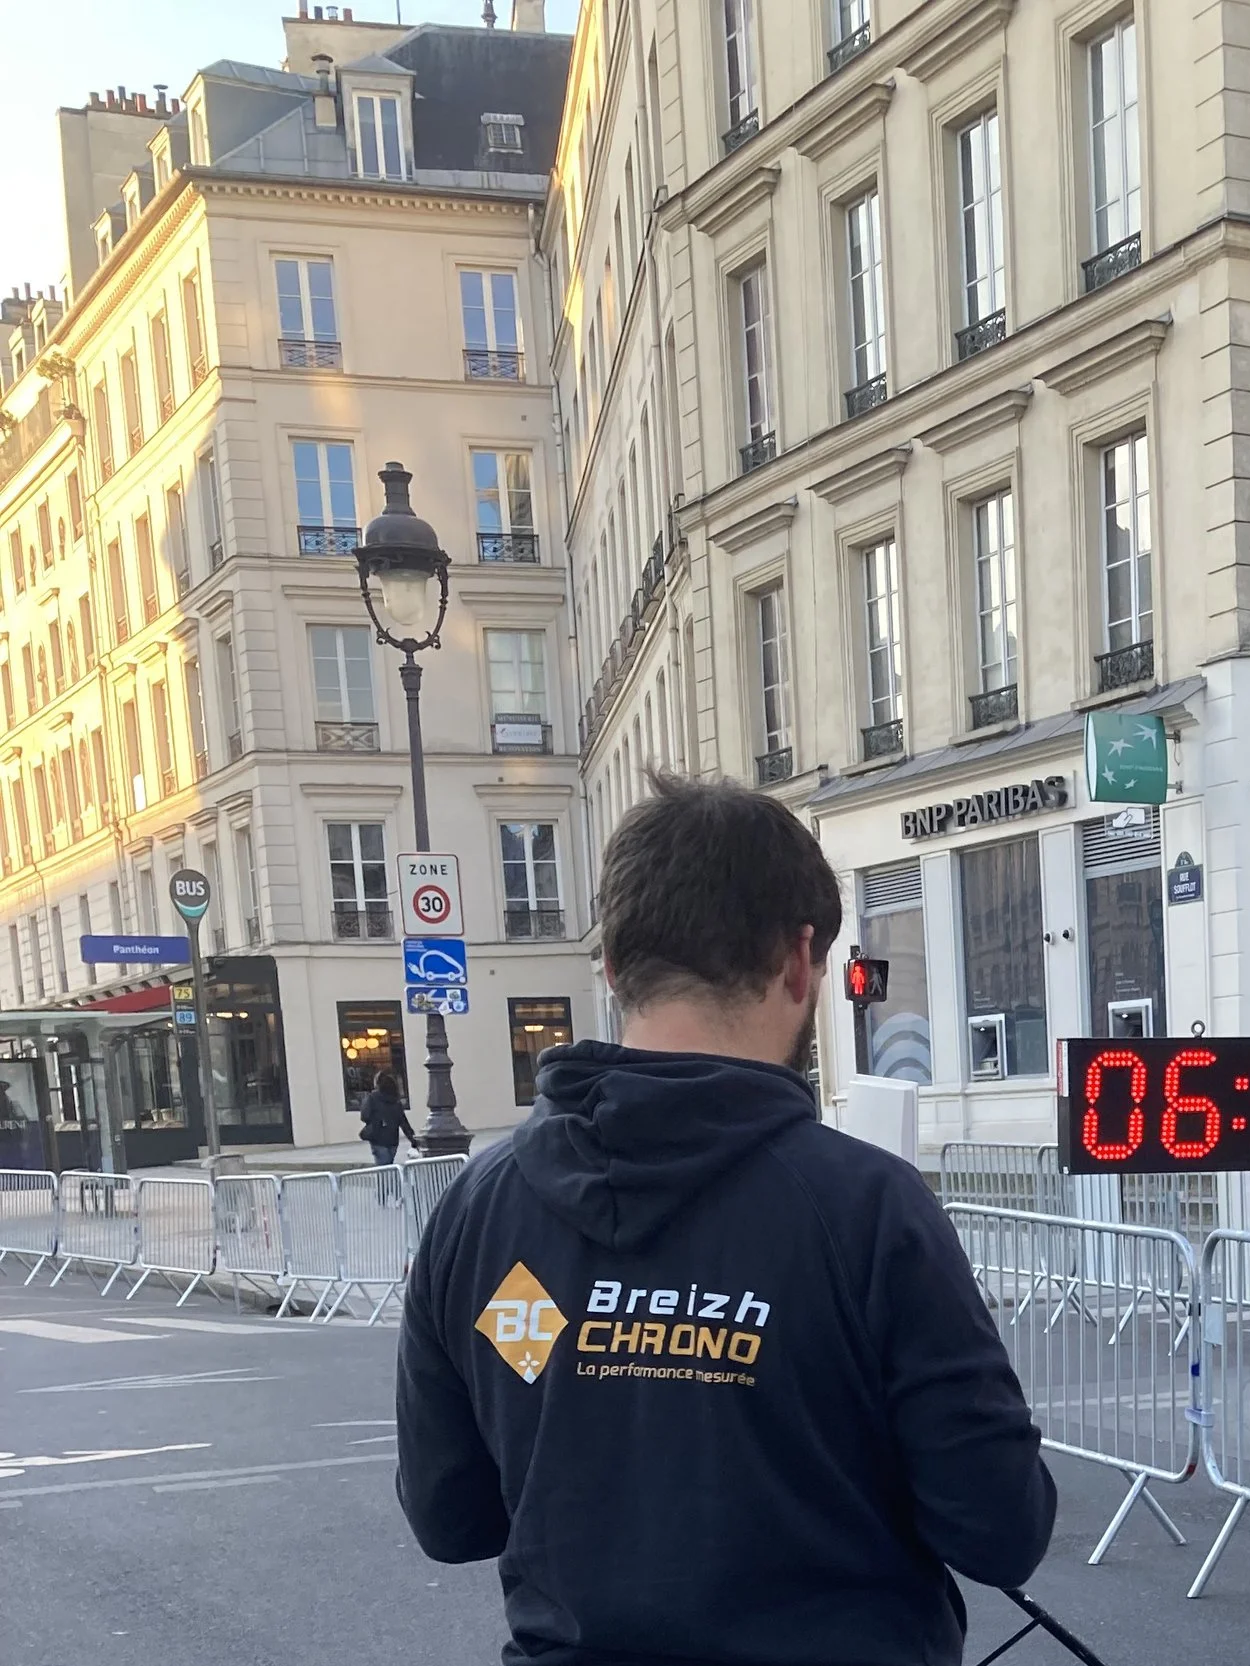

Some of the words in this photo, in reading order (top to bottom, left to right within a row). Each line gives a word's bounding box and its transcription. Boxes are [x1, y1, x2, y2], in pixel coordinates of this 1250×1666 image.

[901, 804, 952, 839] BNP
[953, 776, 1068, 827] PARIBAS
[409, 864, 448, 876] ZONE
[1179, 871, 1189, 882] RUE
[175, 880, 206, 896] BUS
[1173, 881, 1197, 895] SOUFFLOT
[420, 896, 443, 913] 30
[113, 944, 160, 955] Panthéon
[175, 988, 190, 999] 75
[179, 1012, 193, 1023] 89
[586, 1280, 771, 1327] Breizh
[486, 1300, 556, 1342] BC
[577, 1320, 761, 1365] CHRONO
[576, 1362, 596, 1376] La
[695, 1370, 755, 1387] mesurée
